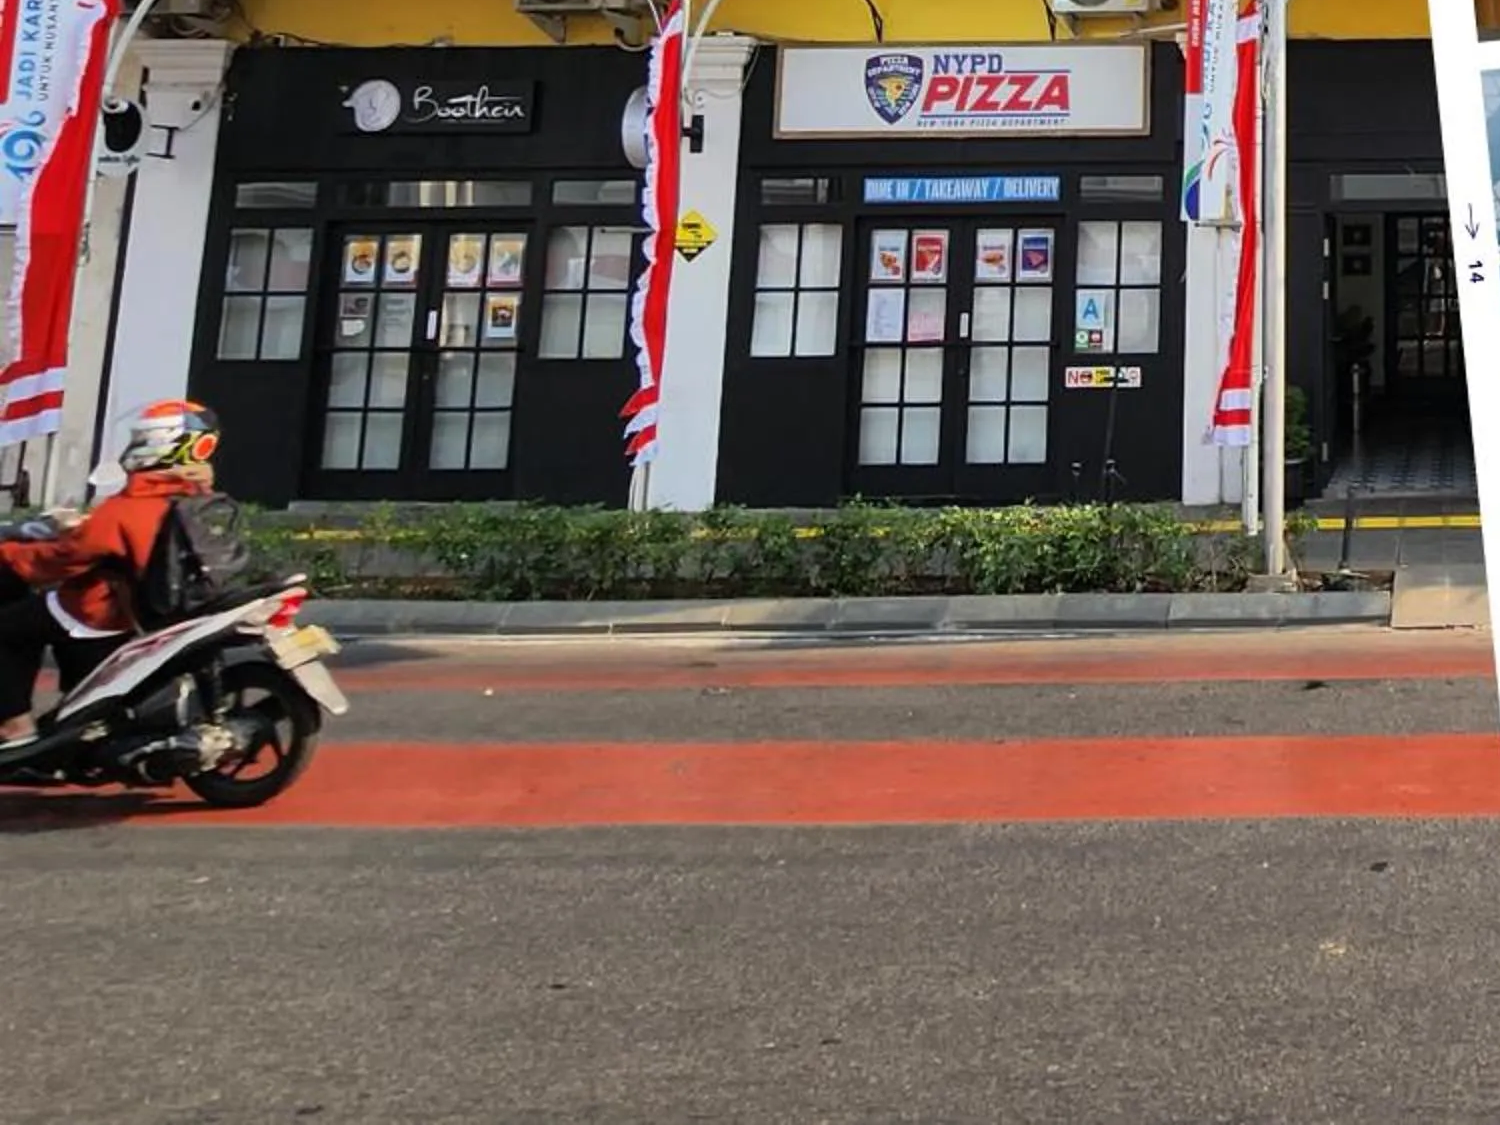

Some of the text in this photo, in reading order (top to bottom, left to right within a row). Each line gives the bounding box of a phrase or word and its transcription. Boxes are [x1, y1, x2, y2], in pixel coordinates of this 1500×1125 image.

[932, 54, 1004, 75] NYPD
[16, 51, 37, 101] JADI
[921, 74, 1070, 112] PIZZA
[924, 178, 989, 199] TAKEAWAY
[1003, 177, 1060, 198] DELIVERY
[1082, 298, 1100, 320] A
